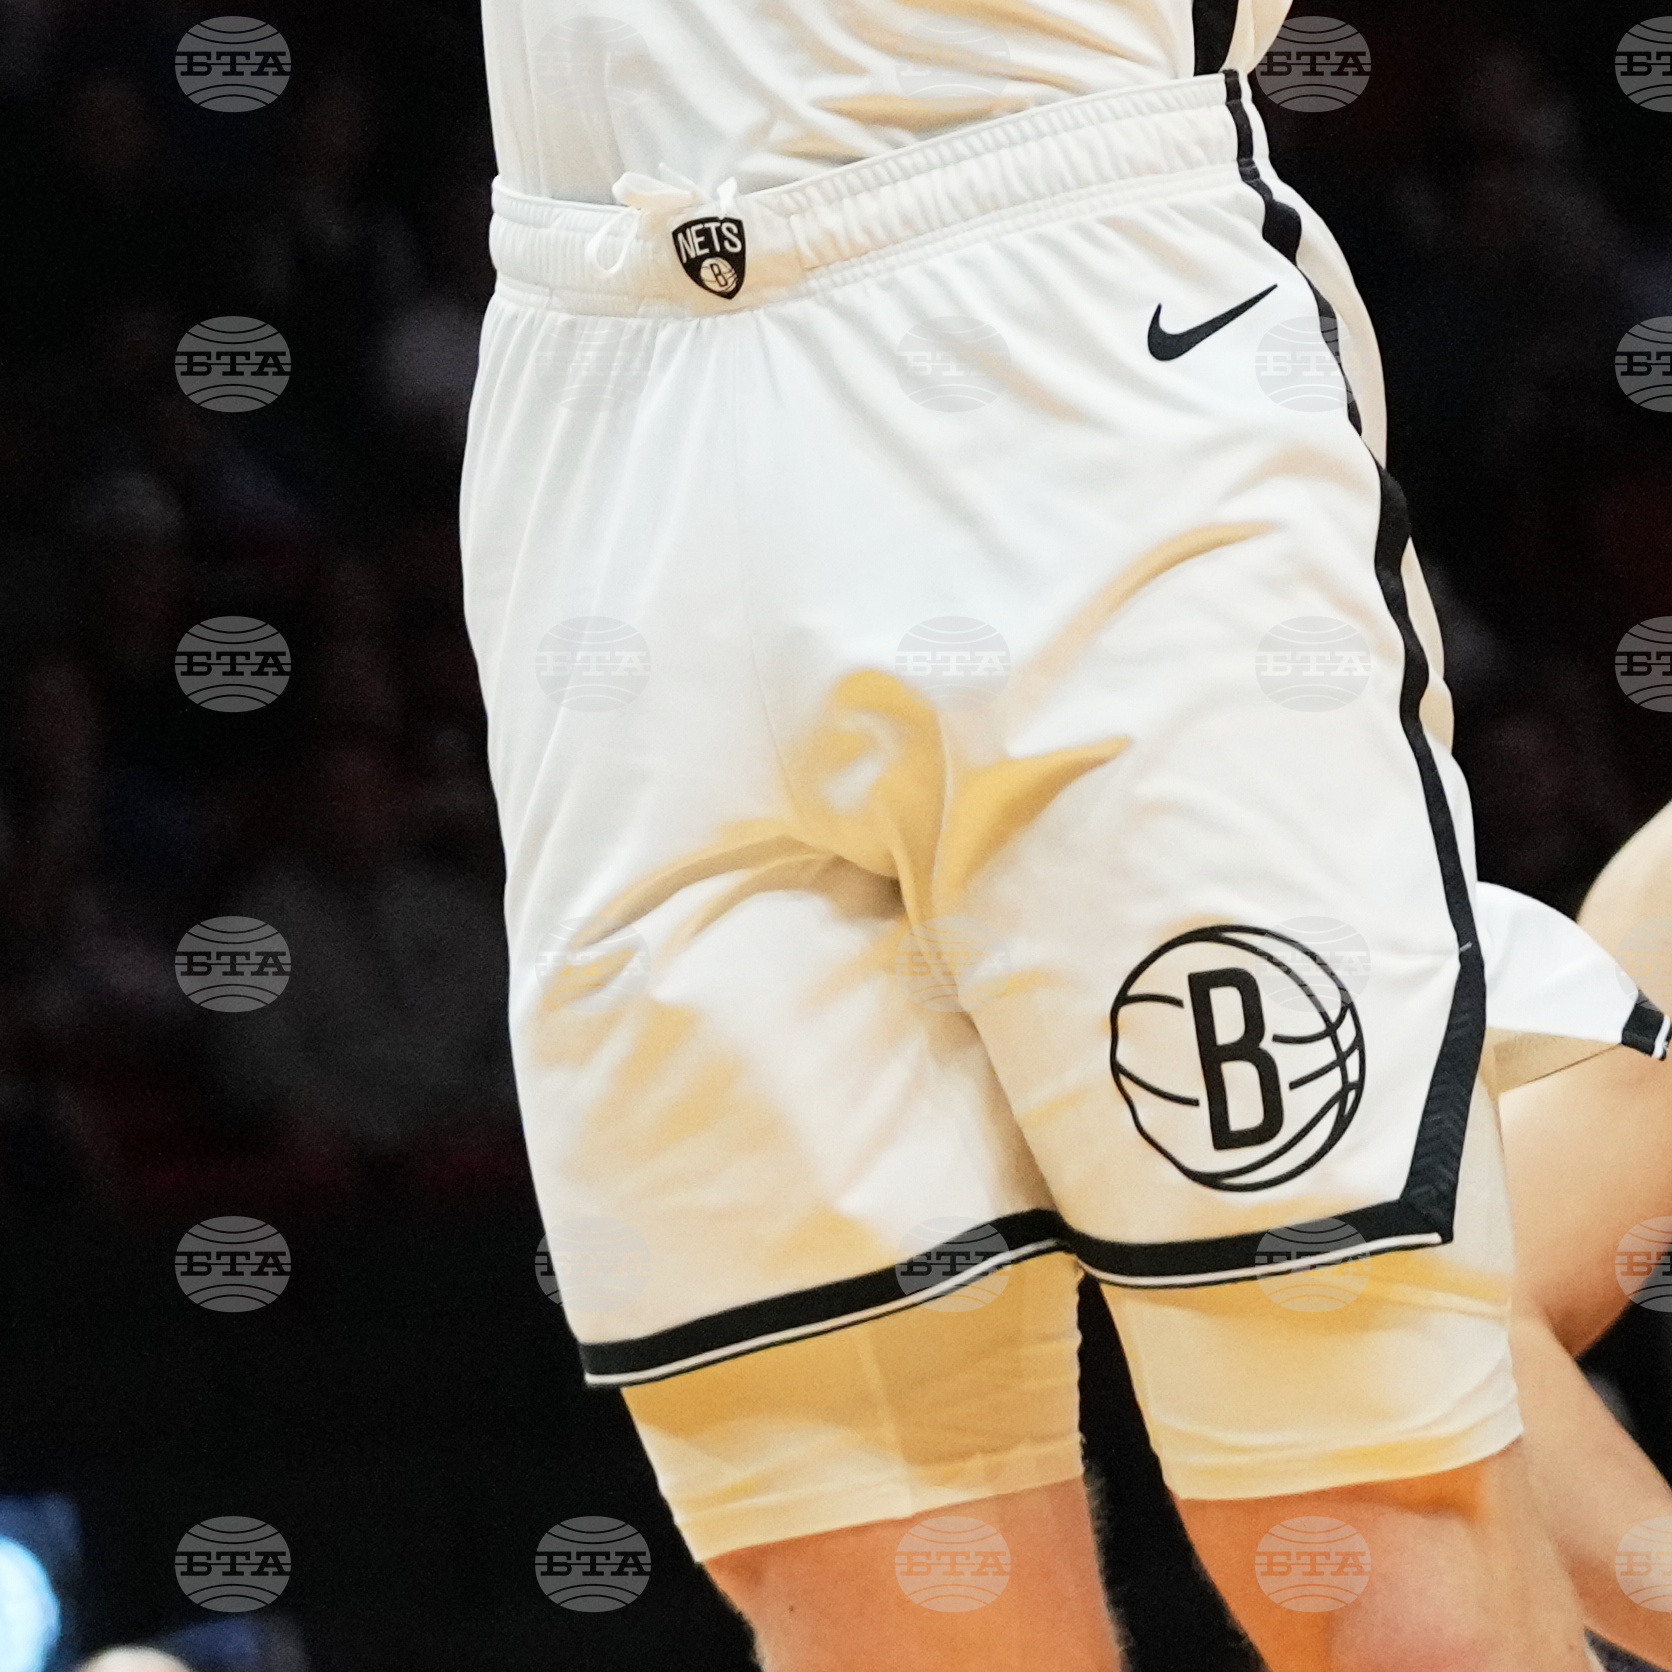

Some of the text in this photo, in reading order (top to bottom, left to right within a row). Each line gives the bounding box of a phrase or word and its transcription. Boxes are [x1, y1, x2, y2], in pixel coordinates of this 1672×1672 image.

[676, 221, 742, 264] NETS
[709, 262, 729, 288] B
[1187, 966, 1284, 1151] B
